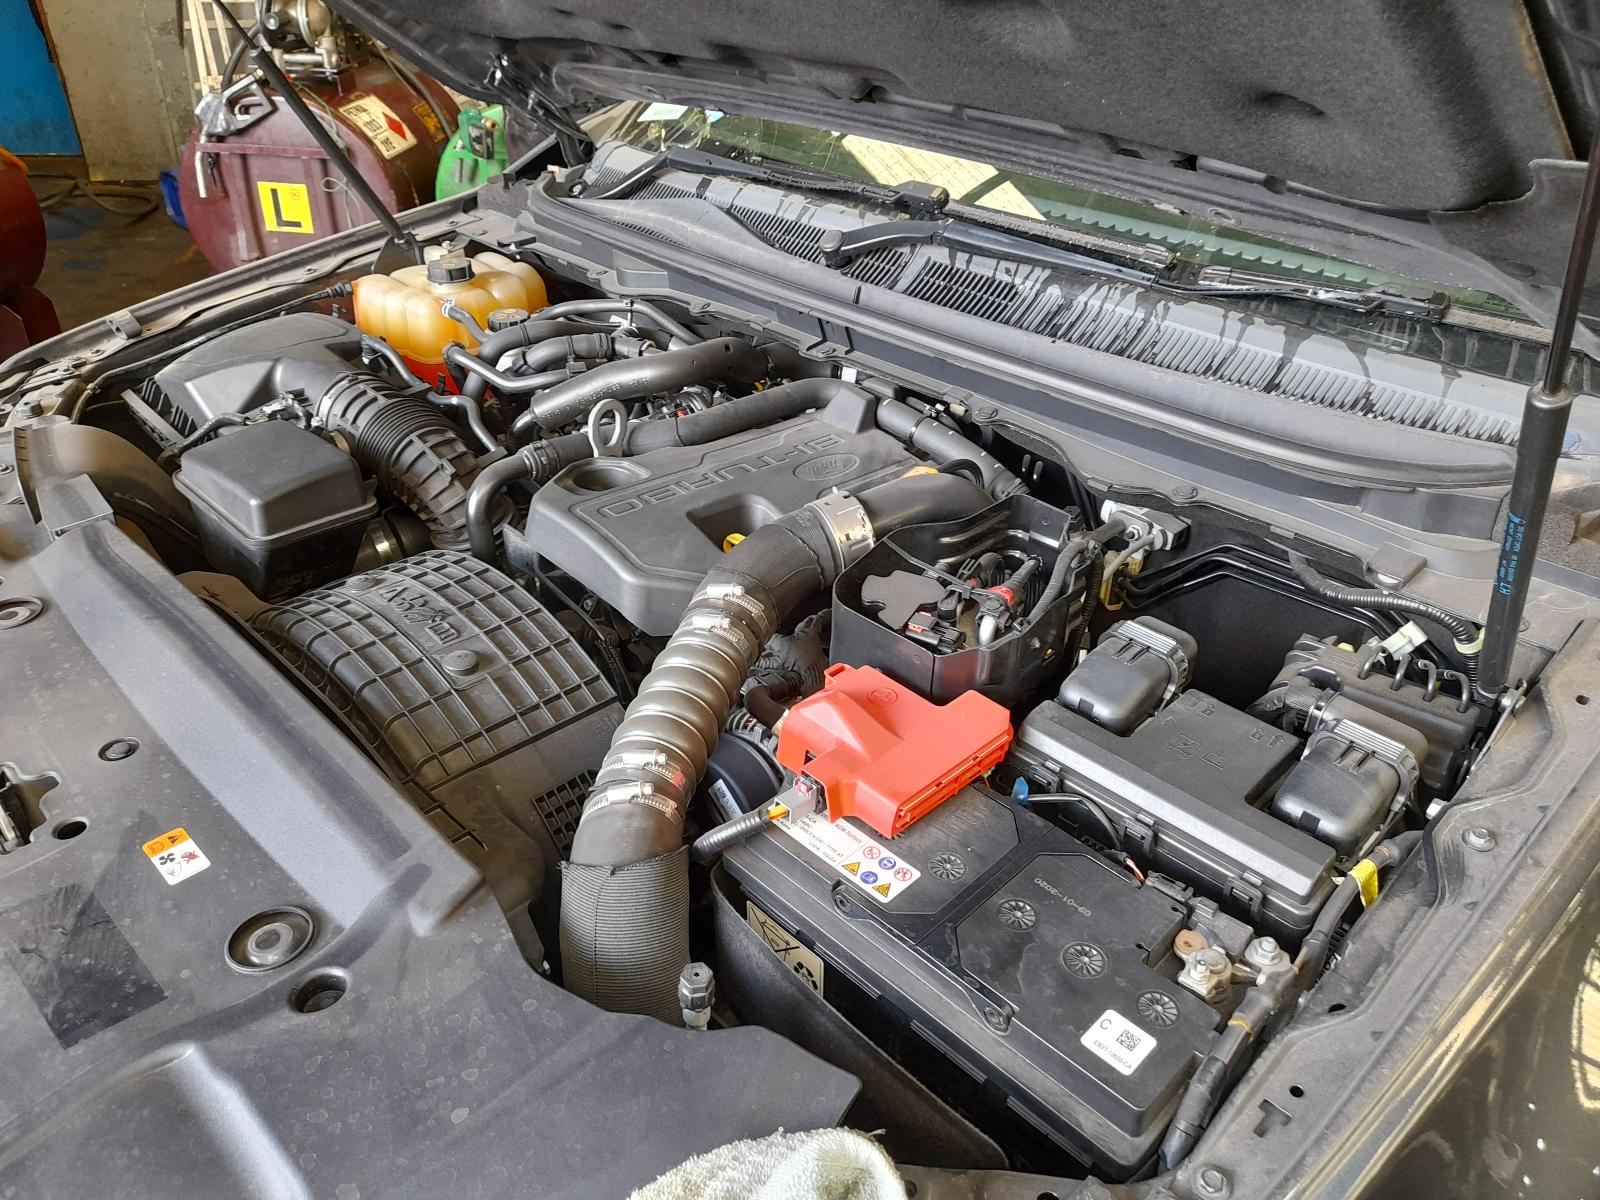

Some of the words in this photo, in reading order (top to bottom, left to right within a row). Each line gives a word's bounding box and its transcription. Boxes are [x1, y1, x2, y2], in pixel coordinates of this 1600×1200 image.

[270, 188, 303, 228] L
[597, 433, 848, 517] BI-TURBO
[804, 456, 850, 479] Ford
[1100, 1019, 1112, 1031] C
